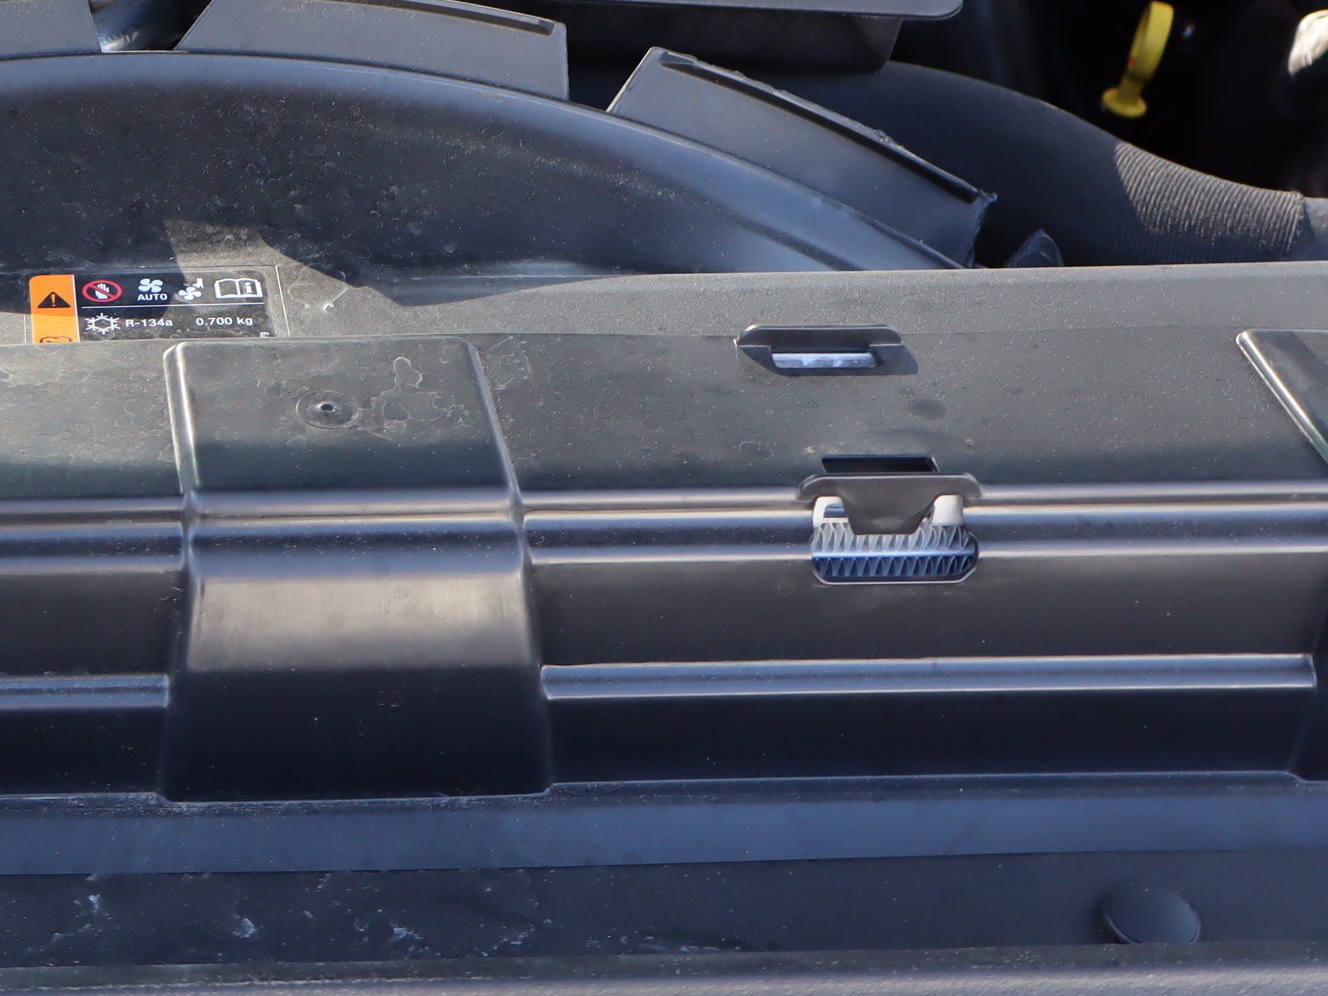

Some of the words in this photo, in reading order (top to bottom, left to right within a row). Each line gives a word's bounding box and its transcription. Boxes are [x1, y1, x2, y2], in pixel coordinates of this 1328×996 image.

[136, 292, 168, 302] AUTO
[125, 317, 174, 328] R-134a
[195, 316, 233, 327] 0.700
[236, 316, 254, 327] kg
